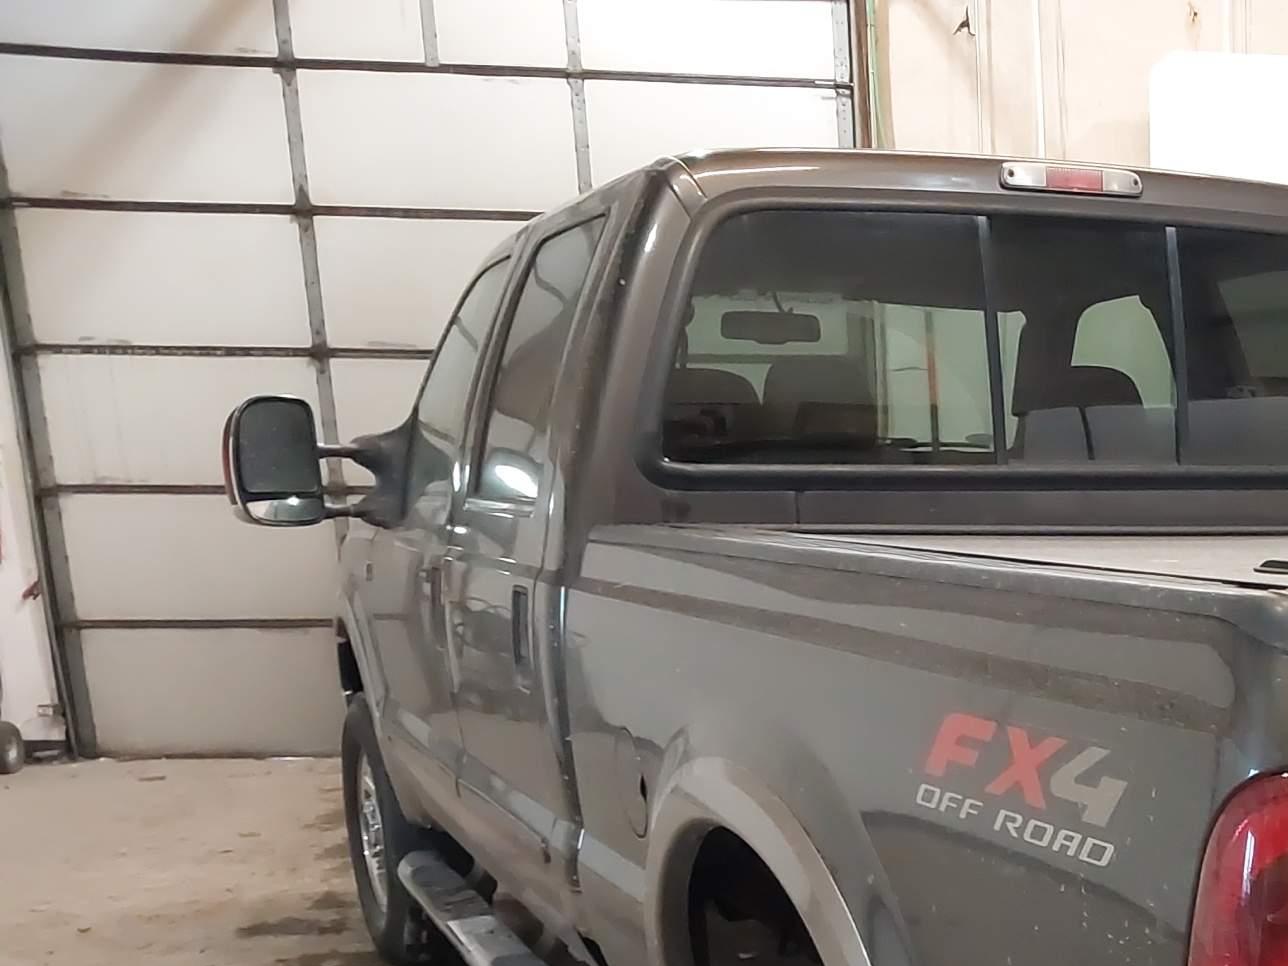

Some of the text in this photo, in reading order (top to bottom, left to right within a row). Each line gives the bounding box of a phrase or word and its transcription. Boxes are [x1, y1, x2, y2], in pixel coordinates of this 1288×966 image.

[924, 713, 1129, 828] FX4
[916, 784, 1115, 867] OFF ROAD
